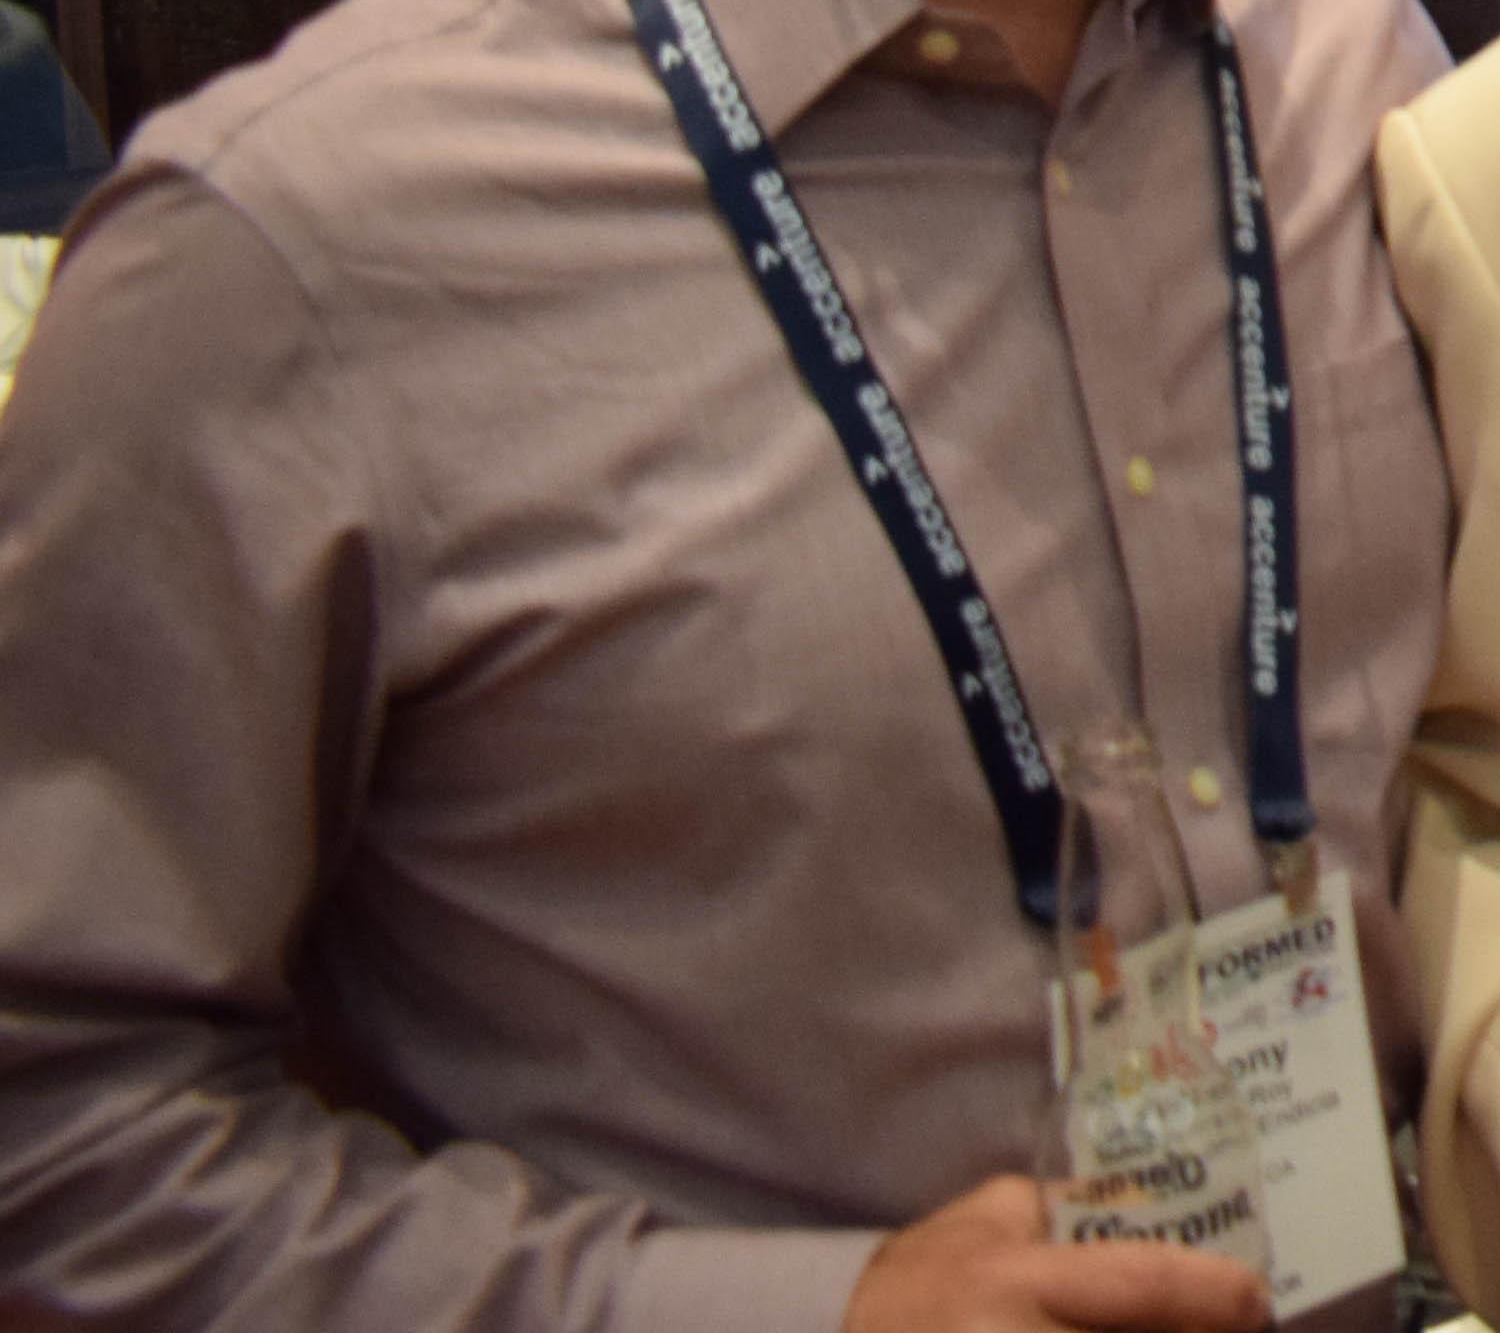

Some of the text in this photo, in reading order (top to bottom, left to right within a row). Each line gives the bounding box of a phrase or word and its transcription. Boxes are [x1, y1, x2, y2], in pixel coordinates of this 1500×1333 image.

[1219, 66, 1261, 253] accenture
[751, 169, 864, 366] accenture
[1238, 273, 1275, 472] accenture
[857, 379, 966, 579] accenture
[958, 595, 1050, 793] accenture
[1250, 493, 1281, 698] accenture
